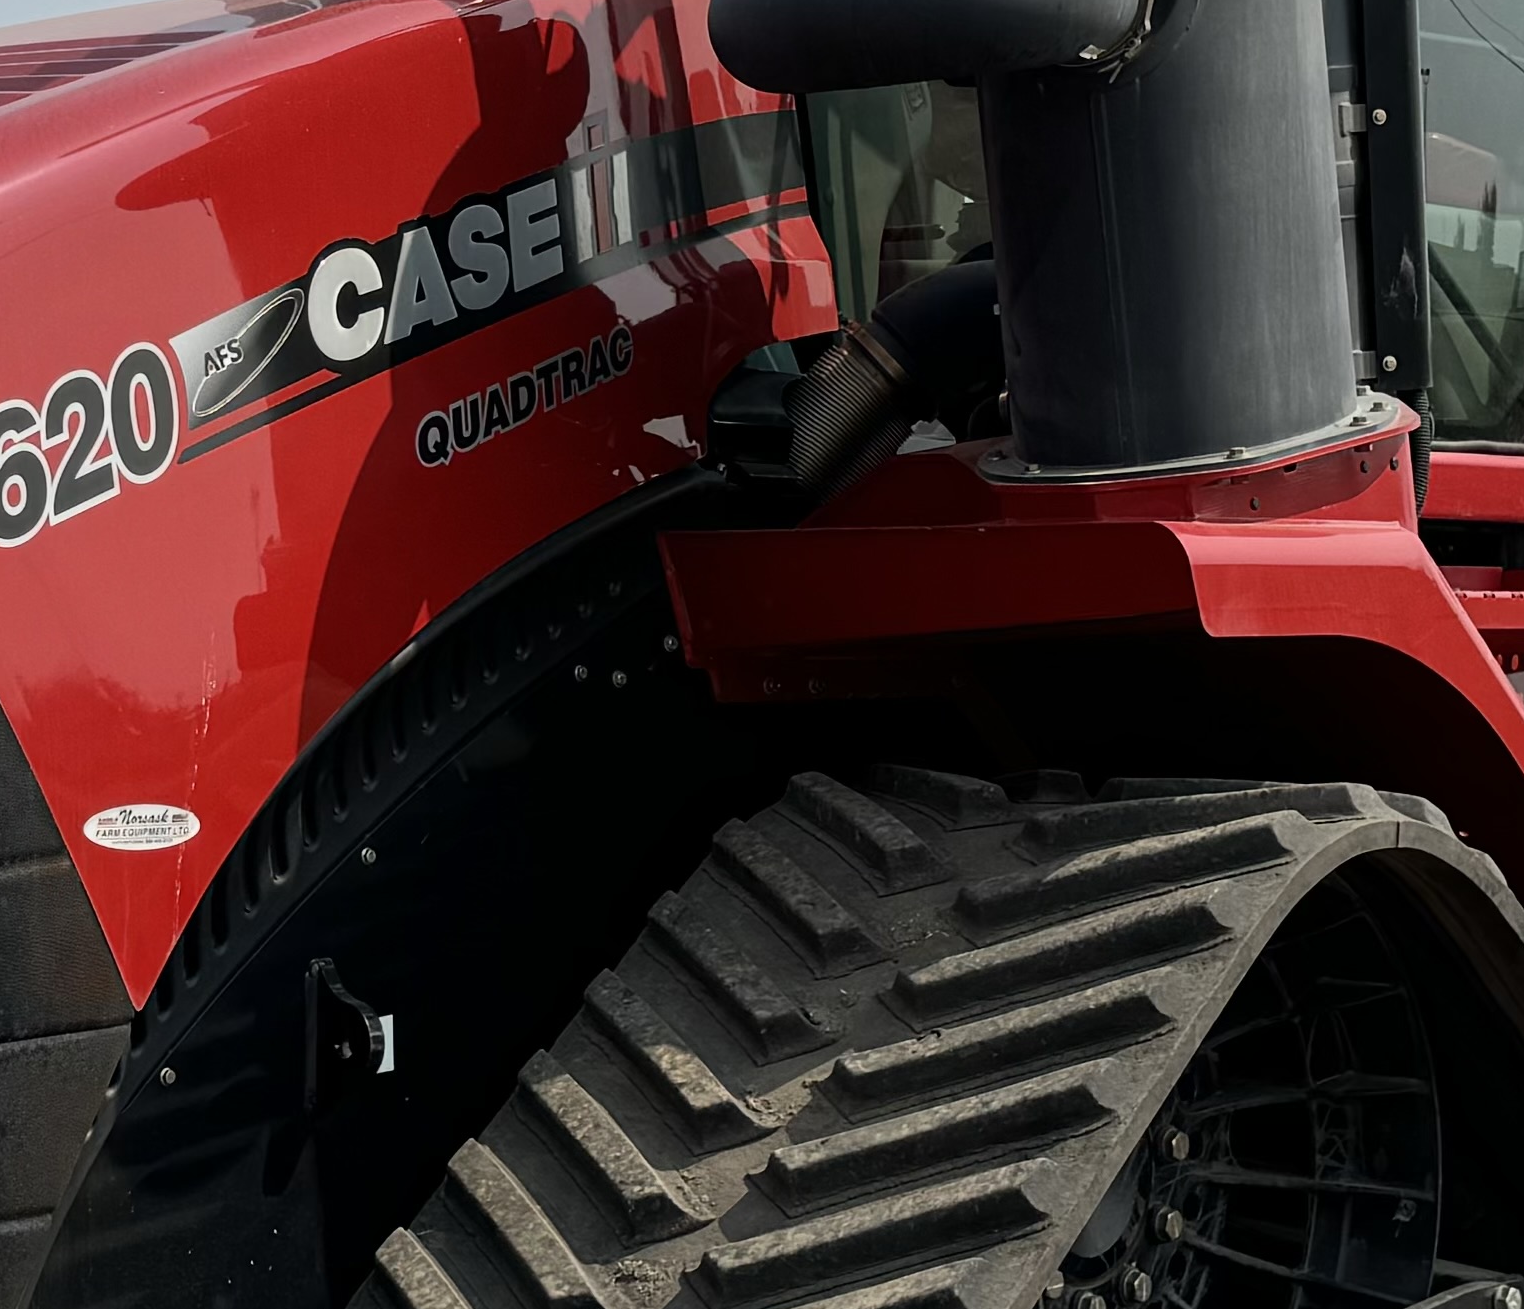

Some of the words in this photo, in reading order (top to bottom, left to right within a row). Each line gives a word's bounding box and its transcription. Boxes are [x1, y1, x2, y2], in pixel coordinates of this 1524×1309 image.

[308, 178, 563, 361] CASE
[204, 339, 243, 377] AFS
[415, 324, 634, 467] QUADTRAC
[95, 828, 121, 837] FARM
[123, 827, 172, 837] EQUIPMENT
[119, 809, 169, 825] Norsask
